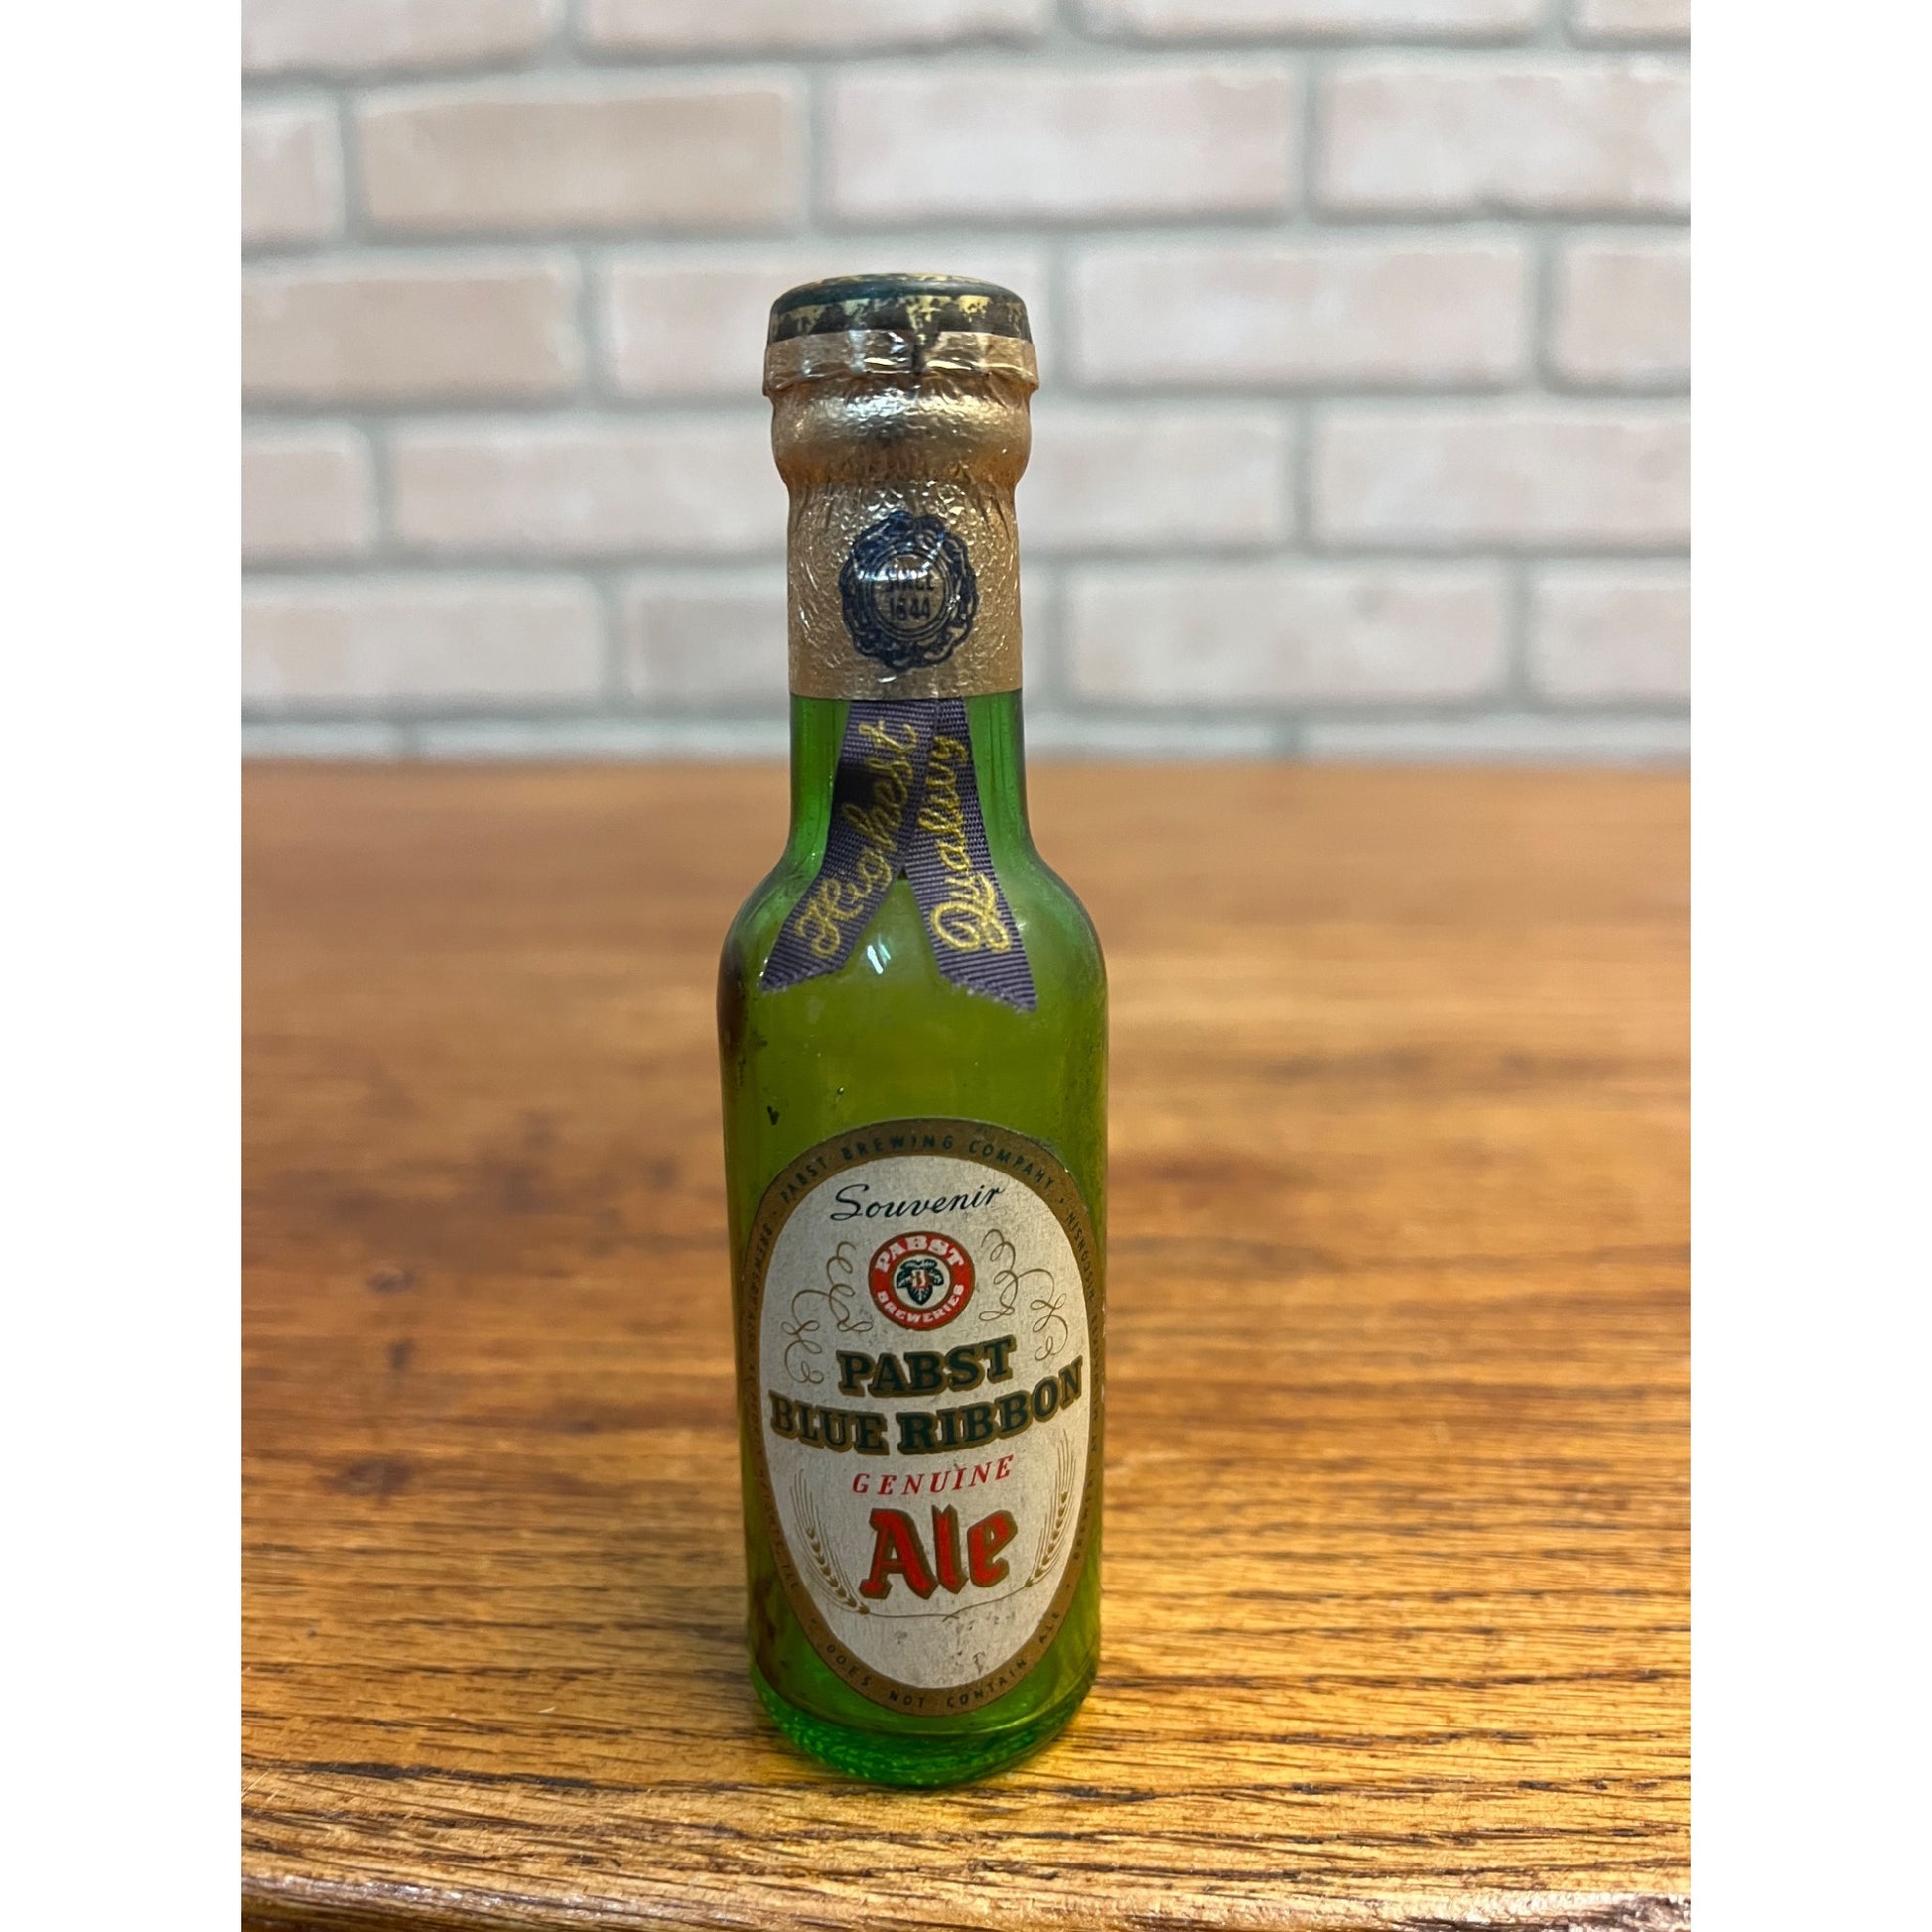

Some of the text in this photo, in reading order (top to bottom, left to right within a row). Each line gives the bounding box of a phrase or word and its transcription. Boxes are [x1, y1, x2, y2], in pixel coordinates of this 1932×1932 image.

[794, 717, 918, 958] Highest
[917, 735, 1012, 953] Quality
[780, 1134, 1055, 1204] PABST BREWING COMPANY
[829, 1183, 1006, 1222] Souvenir
[875, 1235, 965, 1273] PABST
[877, 1284, 964, 1323] BREWERIES
[835, 1334, 1018, 1399] PABST
[768, 1389, 891, 1456] BLUE
[895, 1356, 1085, 1455] RIBBON
[852, 1454, 1015, 1496] GENUINE
[858, 1503, 1020, 1601] Ale
[825, 1611, 1060, 1710] DOES NOT CONTAIN ALE
